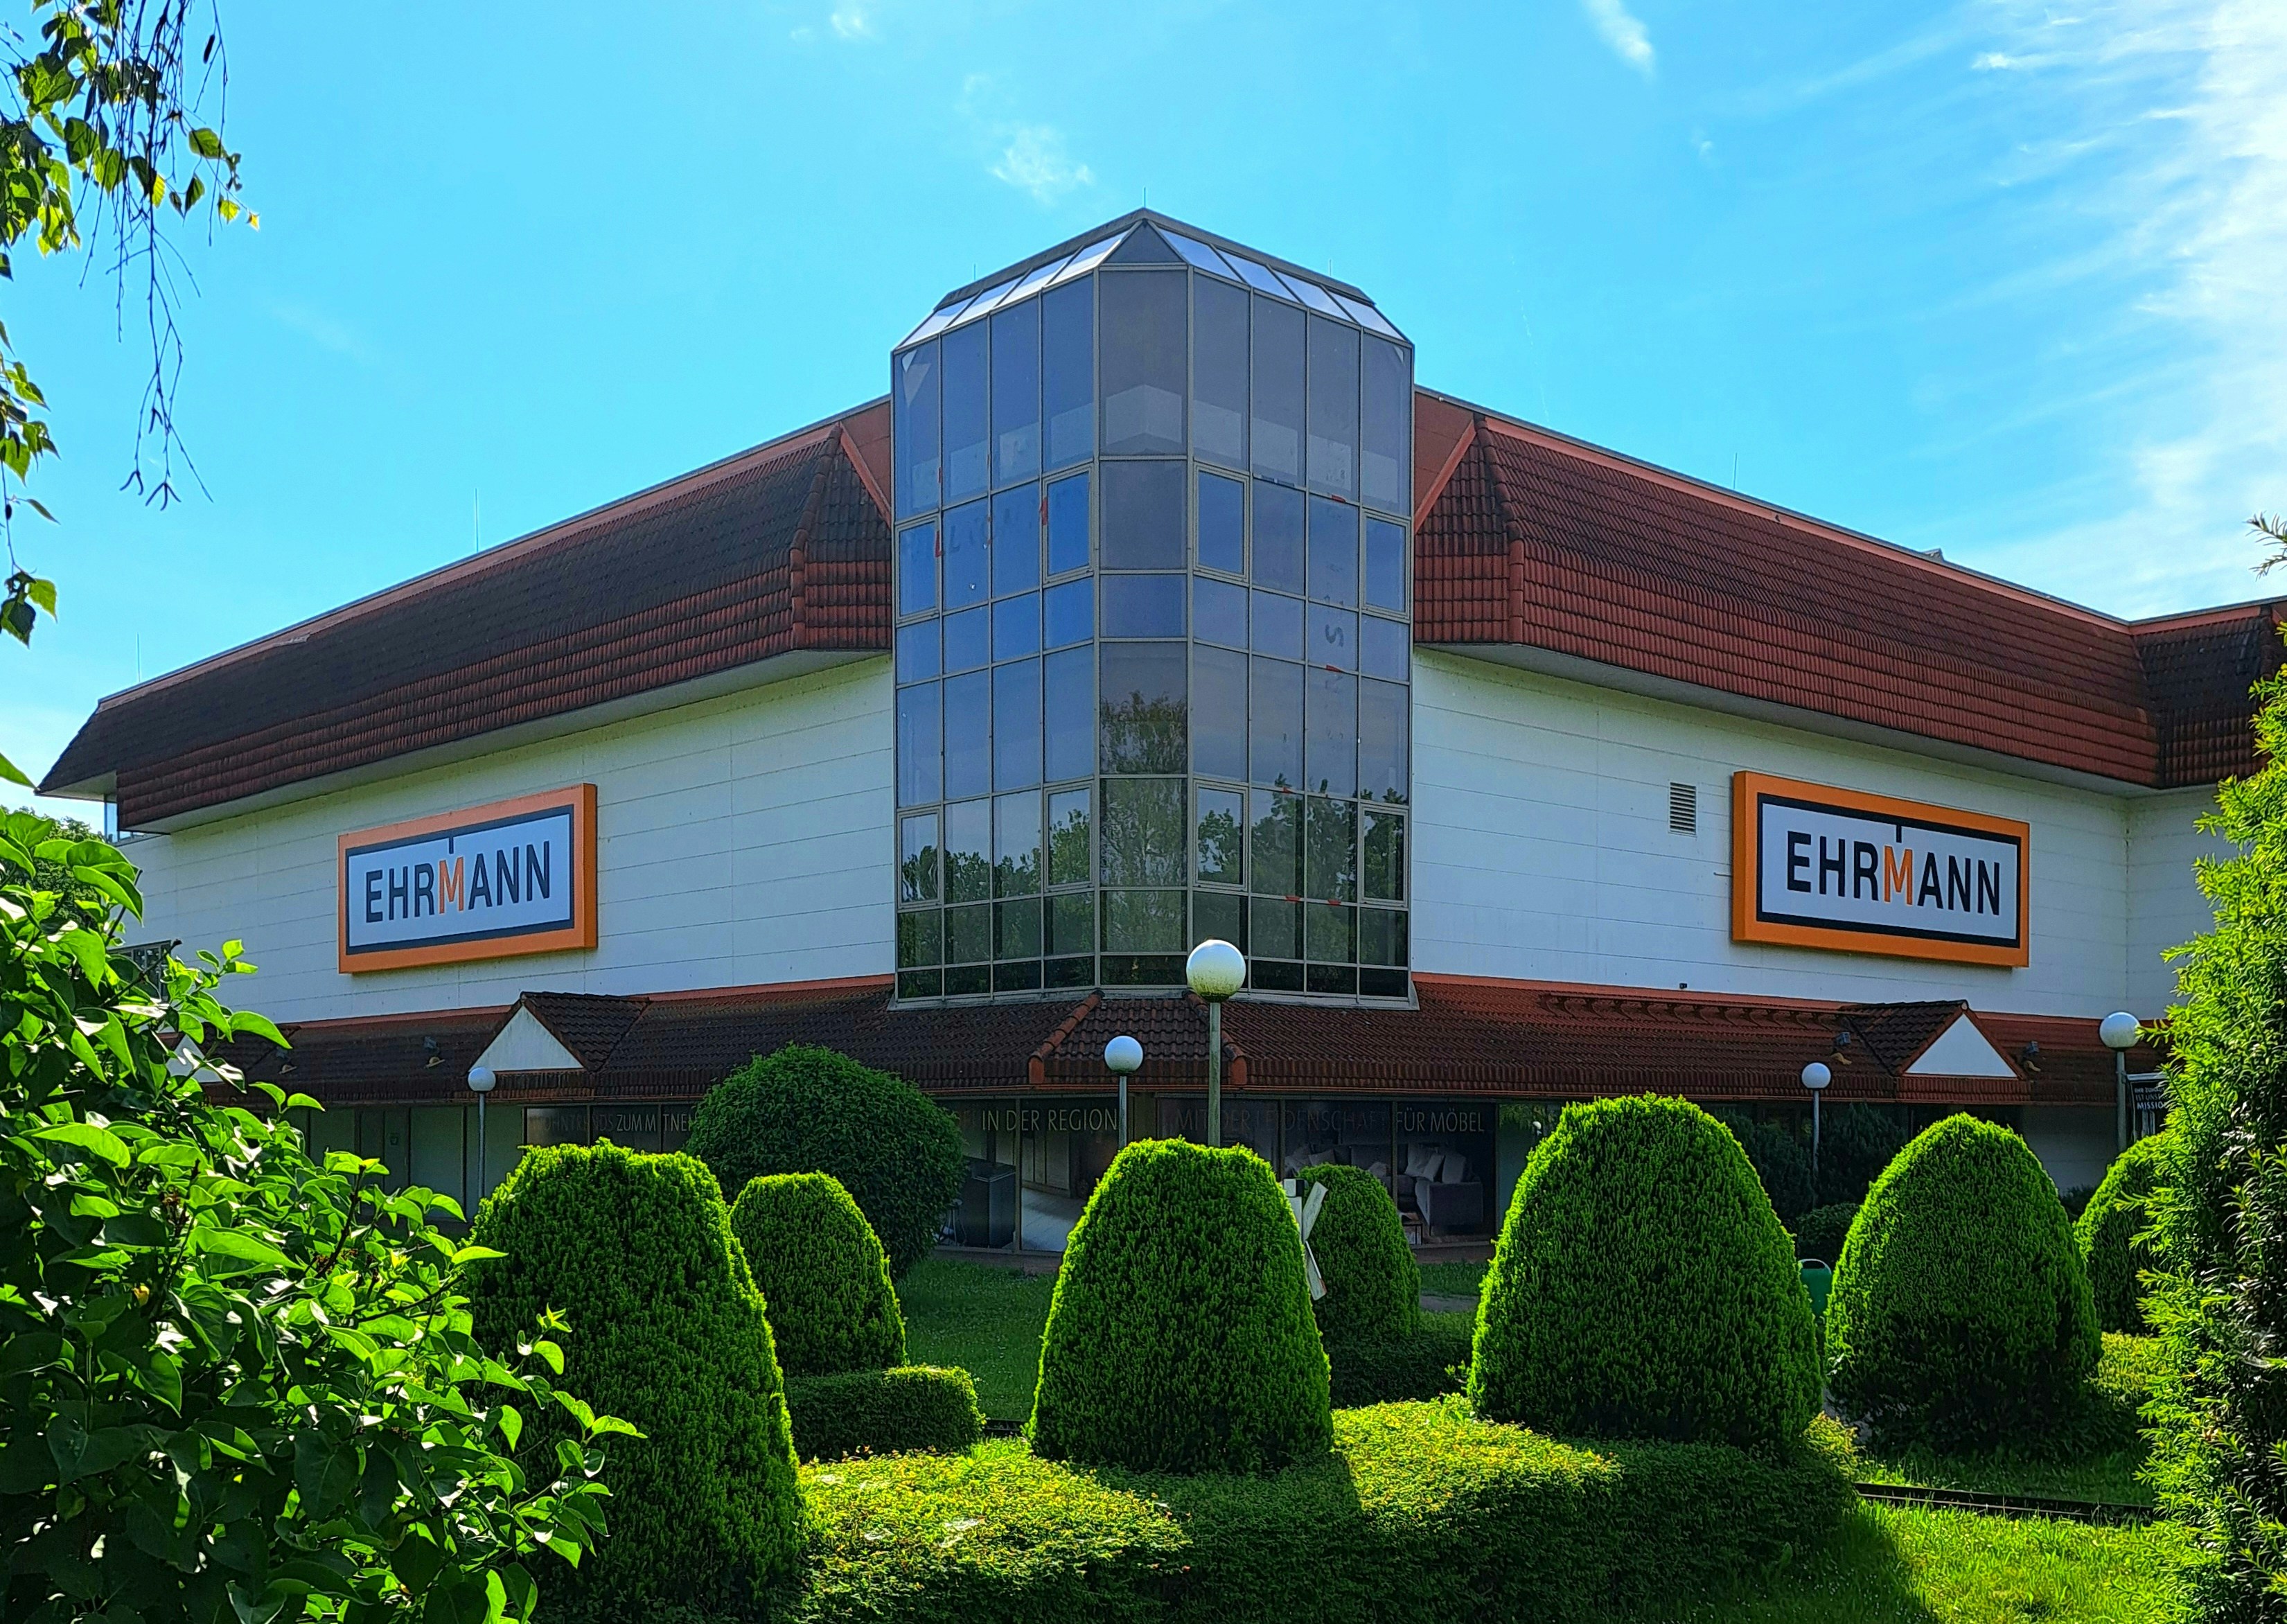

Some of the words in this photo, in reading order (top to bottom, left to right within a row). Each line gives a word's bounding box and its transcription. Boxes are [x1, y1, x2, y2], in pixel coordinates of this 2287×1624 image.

[365, 840, 550, 924] EHRMANN
[1787, 830, 2000, 916] EHRMANN
[616, 1113, 642, 1131] ZUM
[982, 1109, 999, 1131] IN
[1006, 1109, 1040, 1131] DER
[1048, 1108, 1118, 1131] REGION
[1396, 1106, 1426, 1132] FÜR
[1429, 1106, 1485, 1133] MÖBEL
